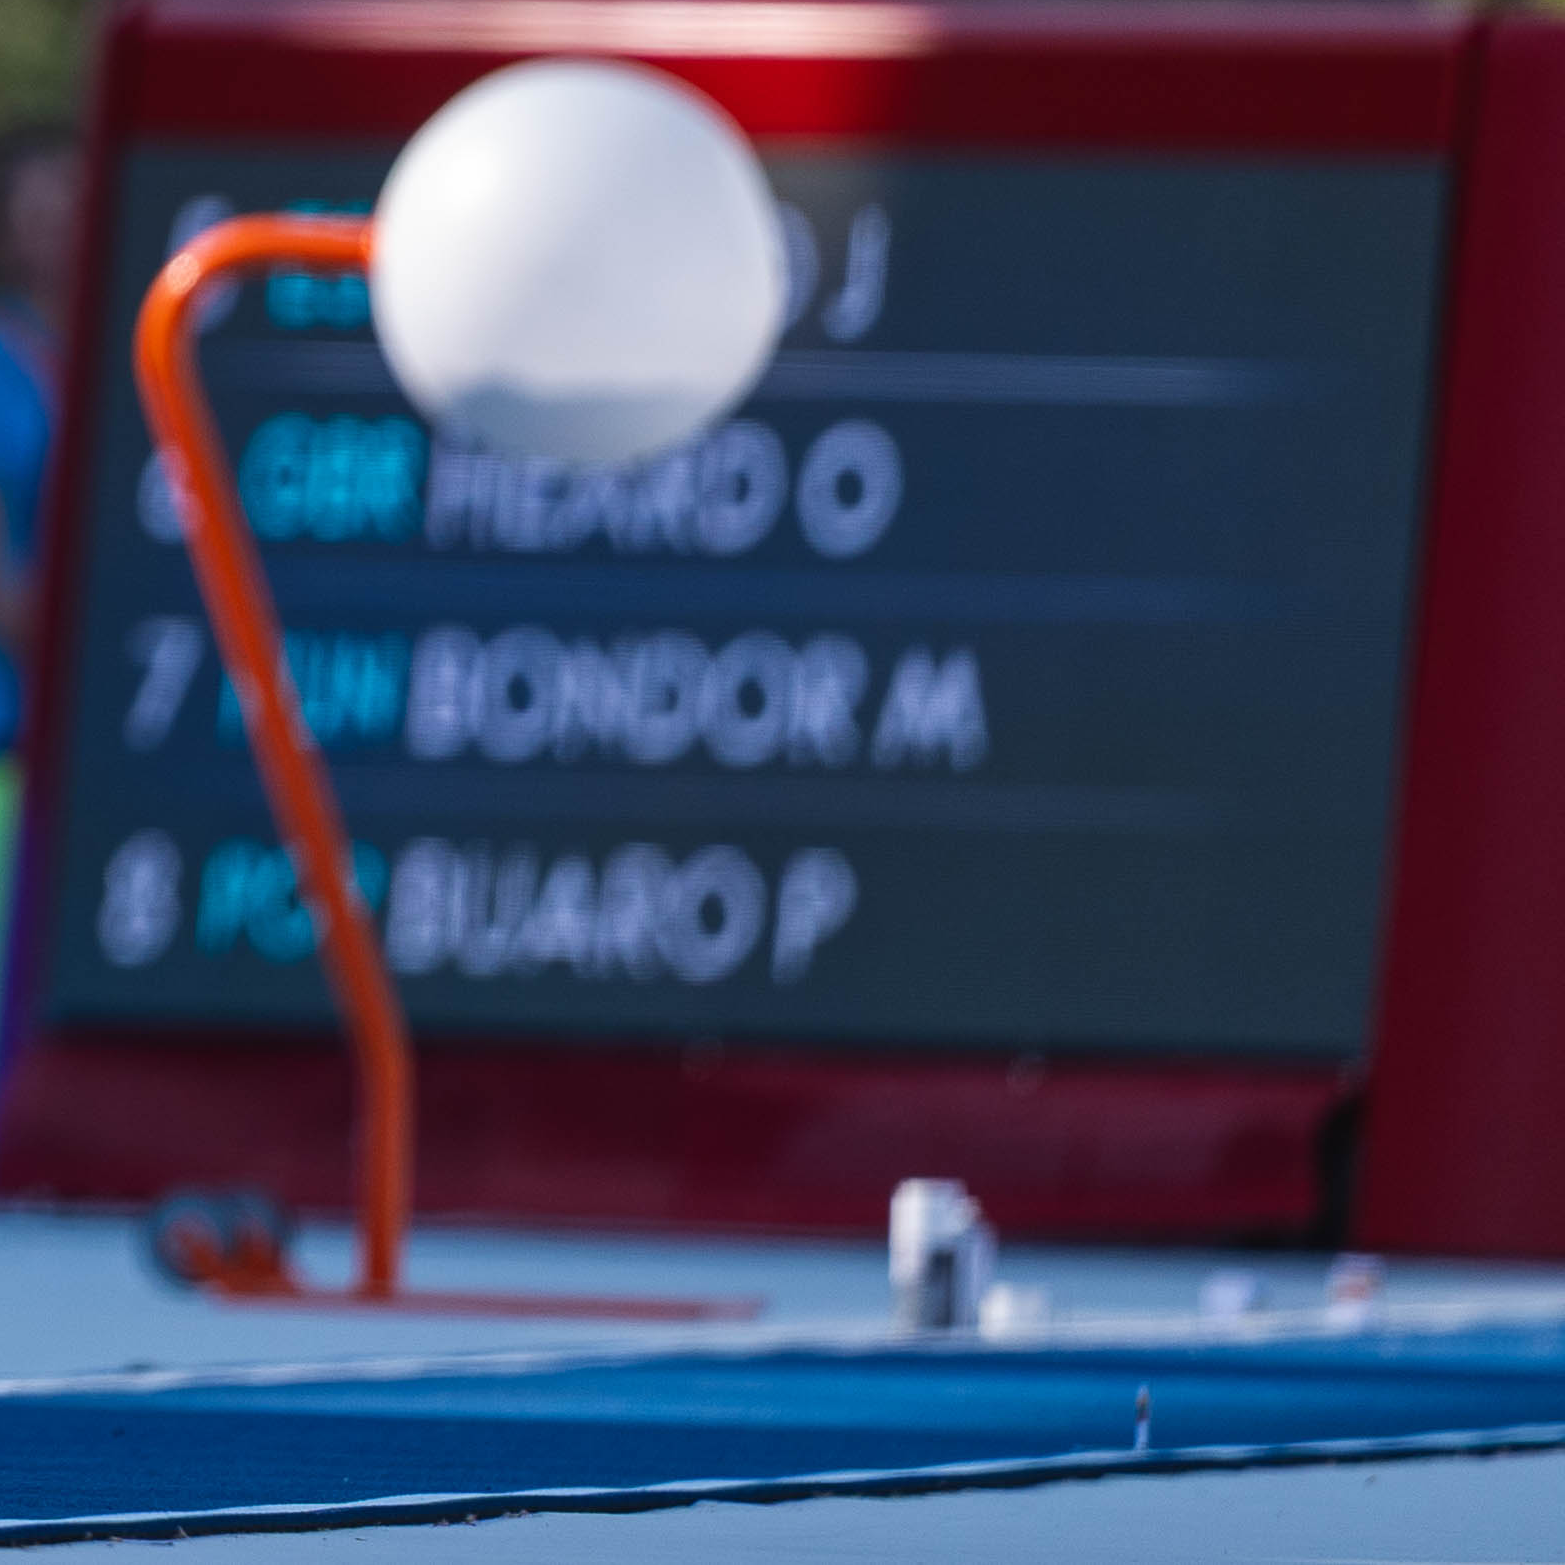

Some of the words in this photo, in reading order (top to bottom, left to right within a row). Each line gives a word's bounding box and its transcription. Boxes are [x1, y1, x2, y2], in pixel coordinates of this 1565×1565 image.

[797, 419, 903, 558] O
[127, 616, 201, 749] 7
[406, 623, 868, 768] BONDOR
[872, 647, 988, 769] M
[98, 828, 182, 968] 8
[385, 837, 767, 983] BUARO
[771, 847, 858, 985] P
